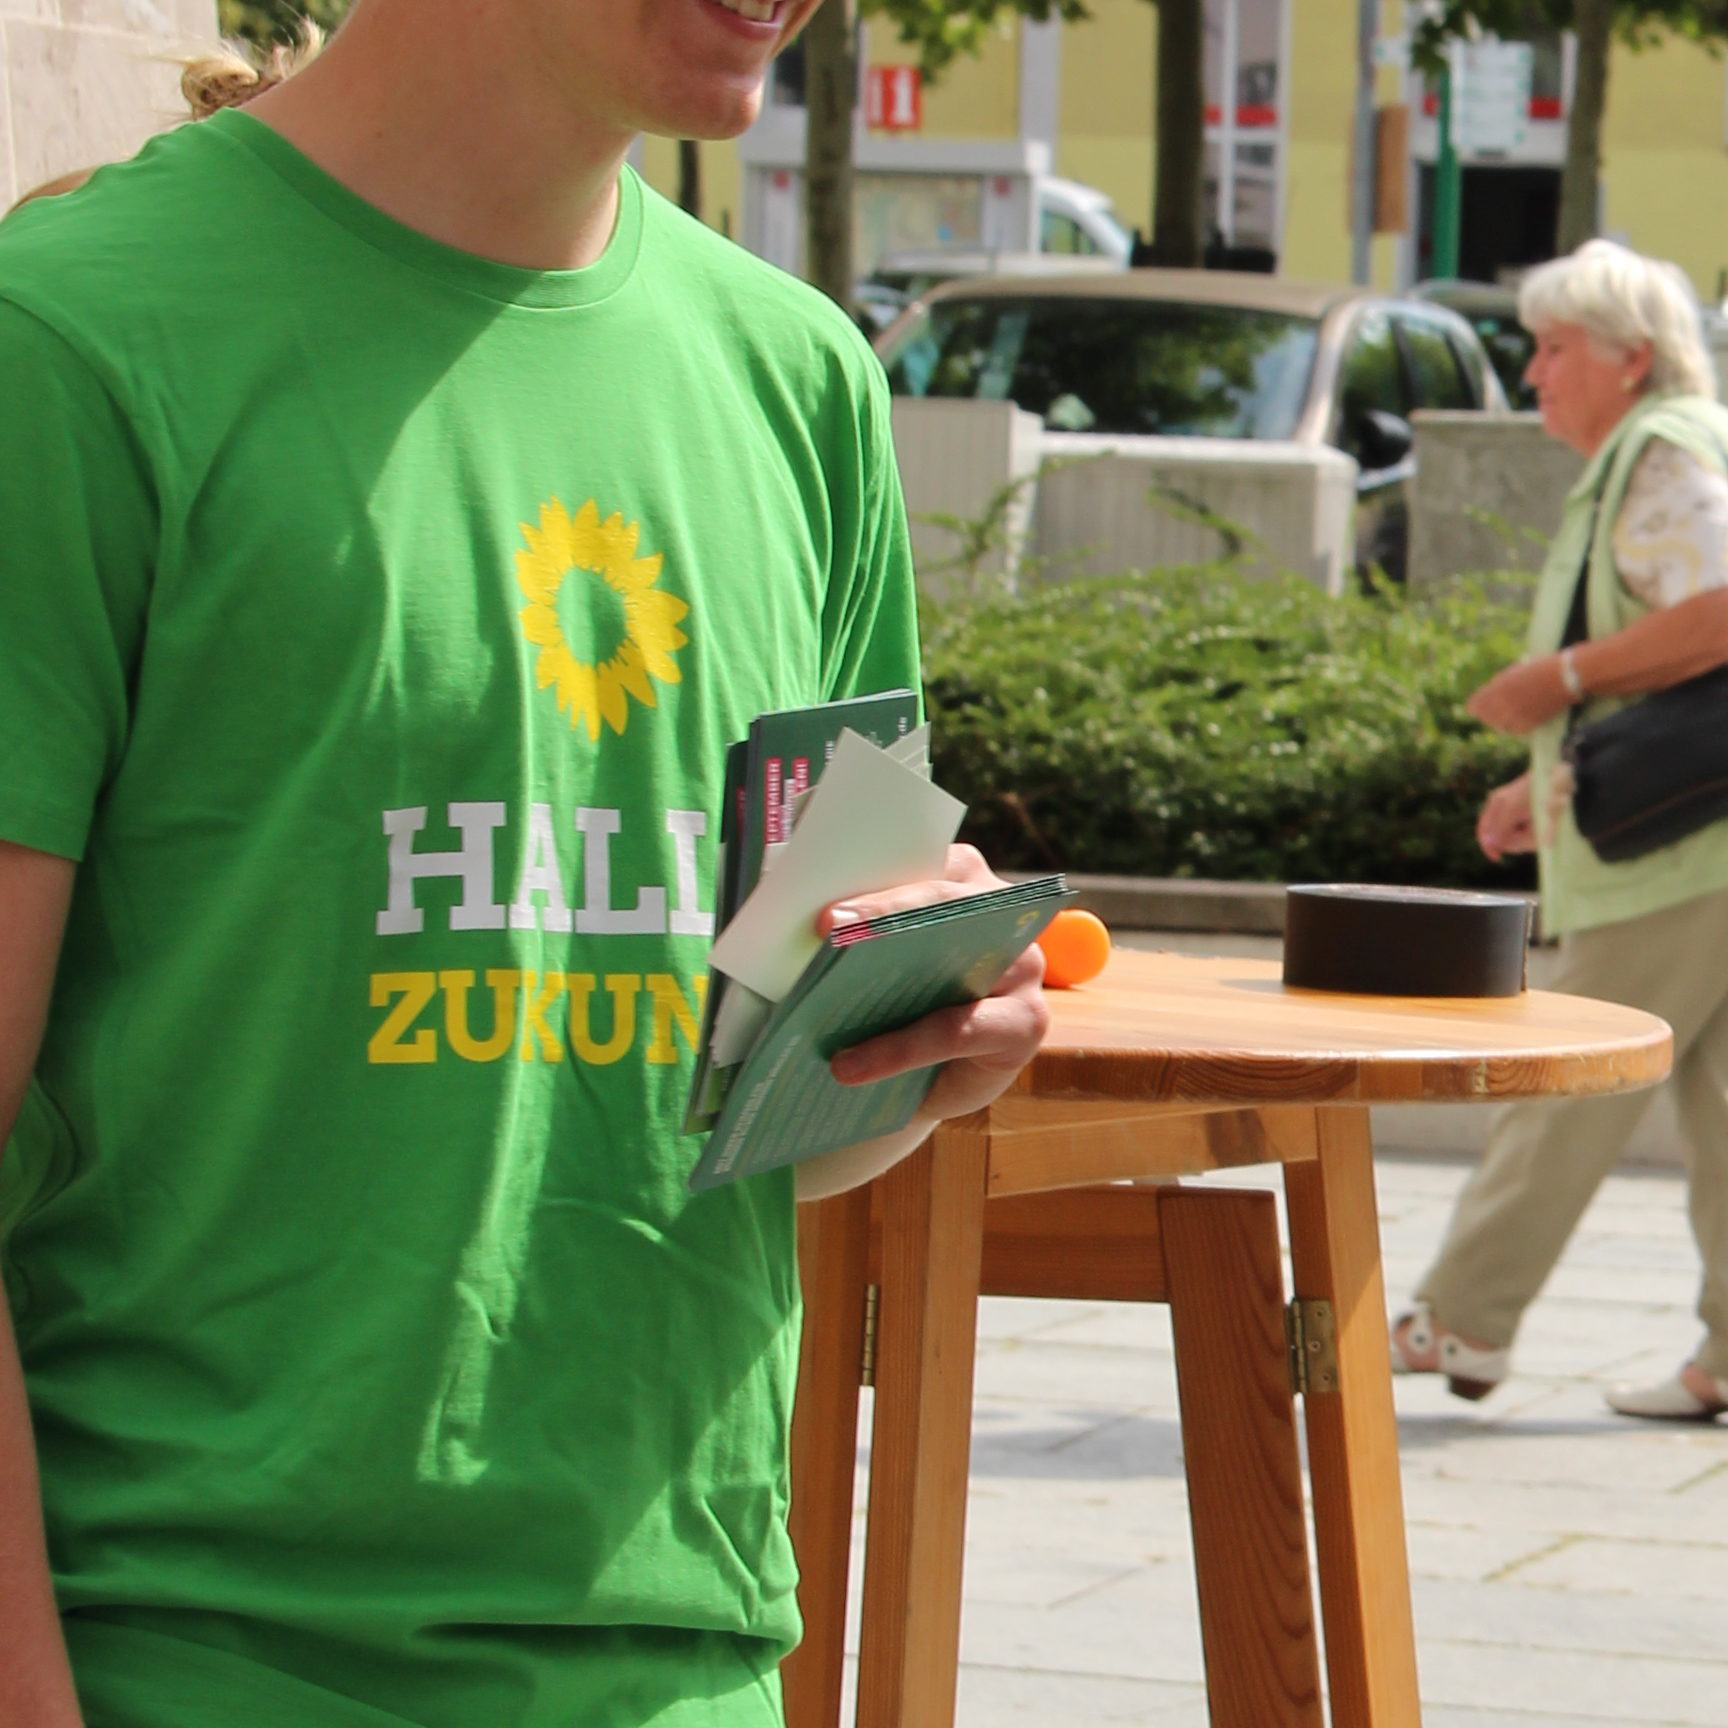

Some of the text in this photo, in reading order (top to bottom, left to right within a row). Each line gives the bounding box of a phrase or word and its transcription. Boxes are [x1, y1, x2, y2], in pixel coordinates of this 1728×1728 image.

[767, 762, 781, 843] EPTEMBER
[375, 801, 717, 936] HALL
[367, 969, 710, 1066] ZUKUN
